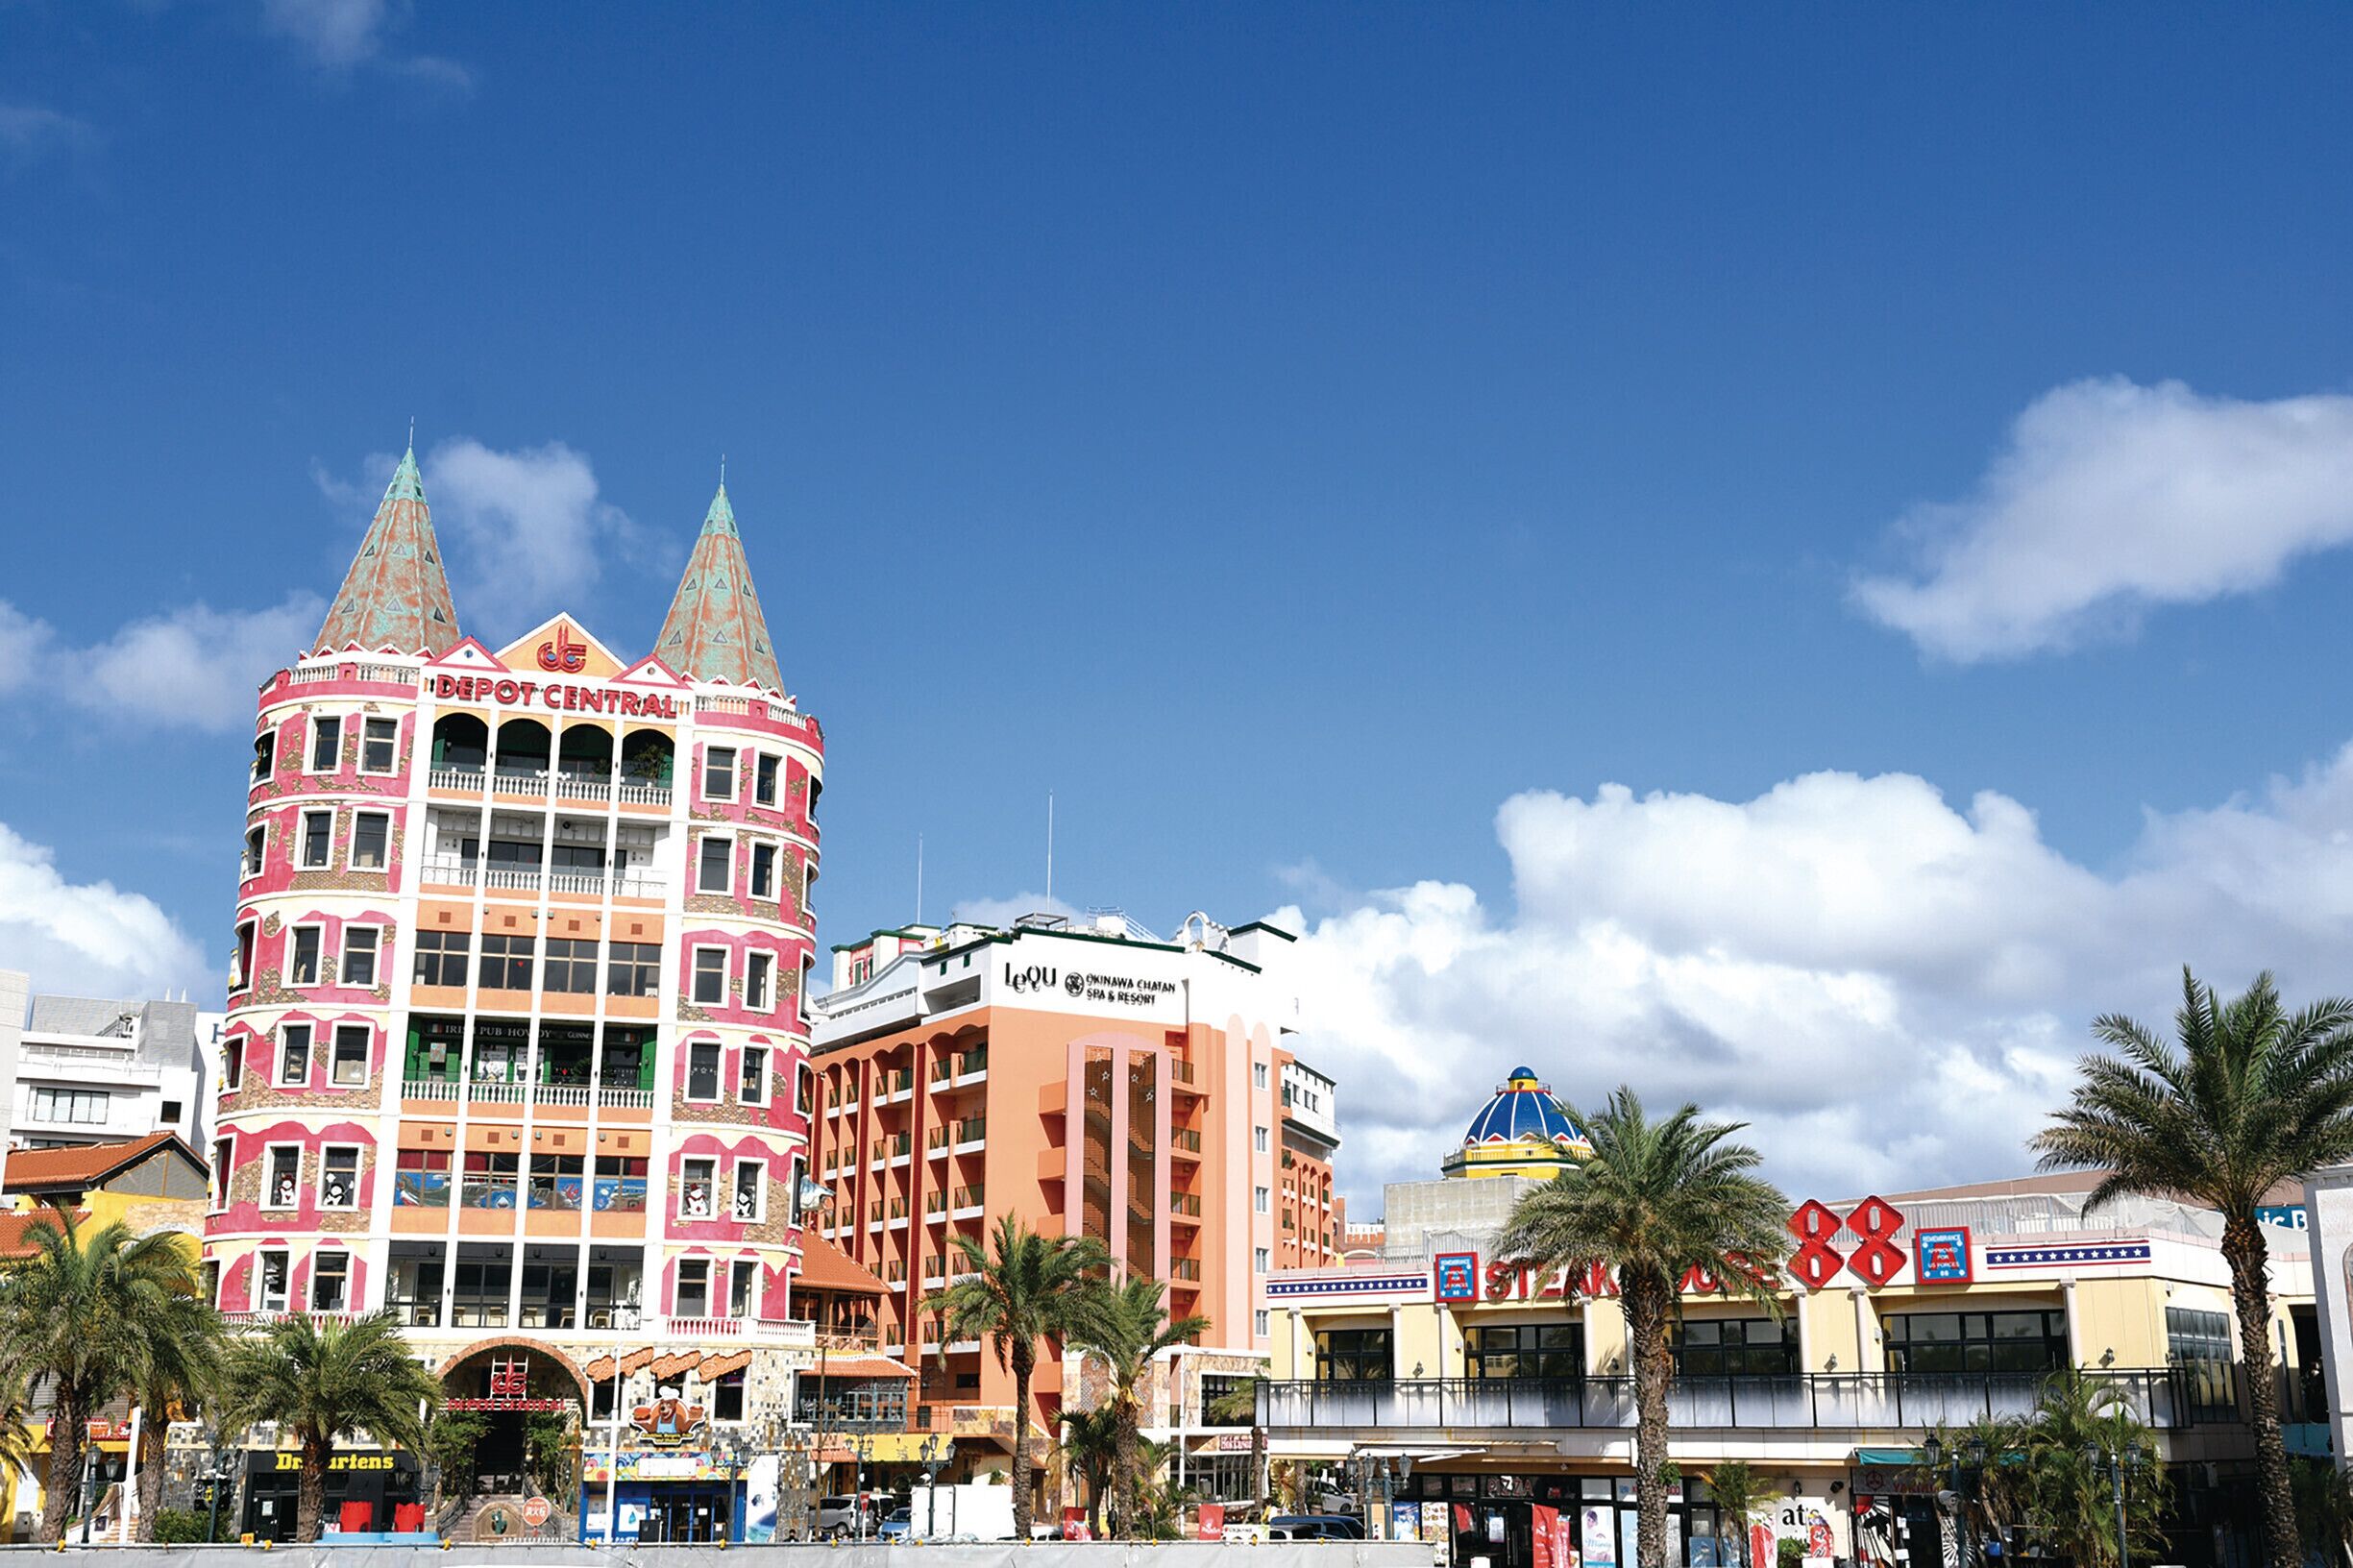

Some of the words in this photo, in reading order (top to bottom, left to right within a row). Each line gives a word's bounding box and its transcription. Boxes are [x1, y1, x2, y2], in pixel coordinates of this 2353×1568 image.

[435, 674, 536, 706] DEPOT
[543, 683, 677, 719] CENTRAL
[1086, 973, 1134, 989] OKINAWA
[1137, 978, 1176, 993] CHATAN
[1087, 988, 1106, 1001] SPA
[1108, 991, 1115, 1003] &
[1117, 992, 1156, 1006] RESORT
[479, 1026, 502, 1037] PUB
[1785, 1195, 1907, 1288] 88
[1487, 1476, 1534, 1497] PIZZA
